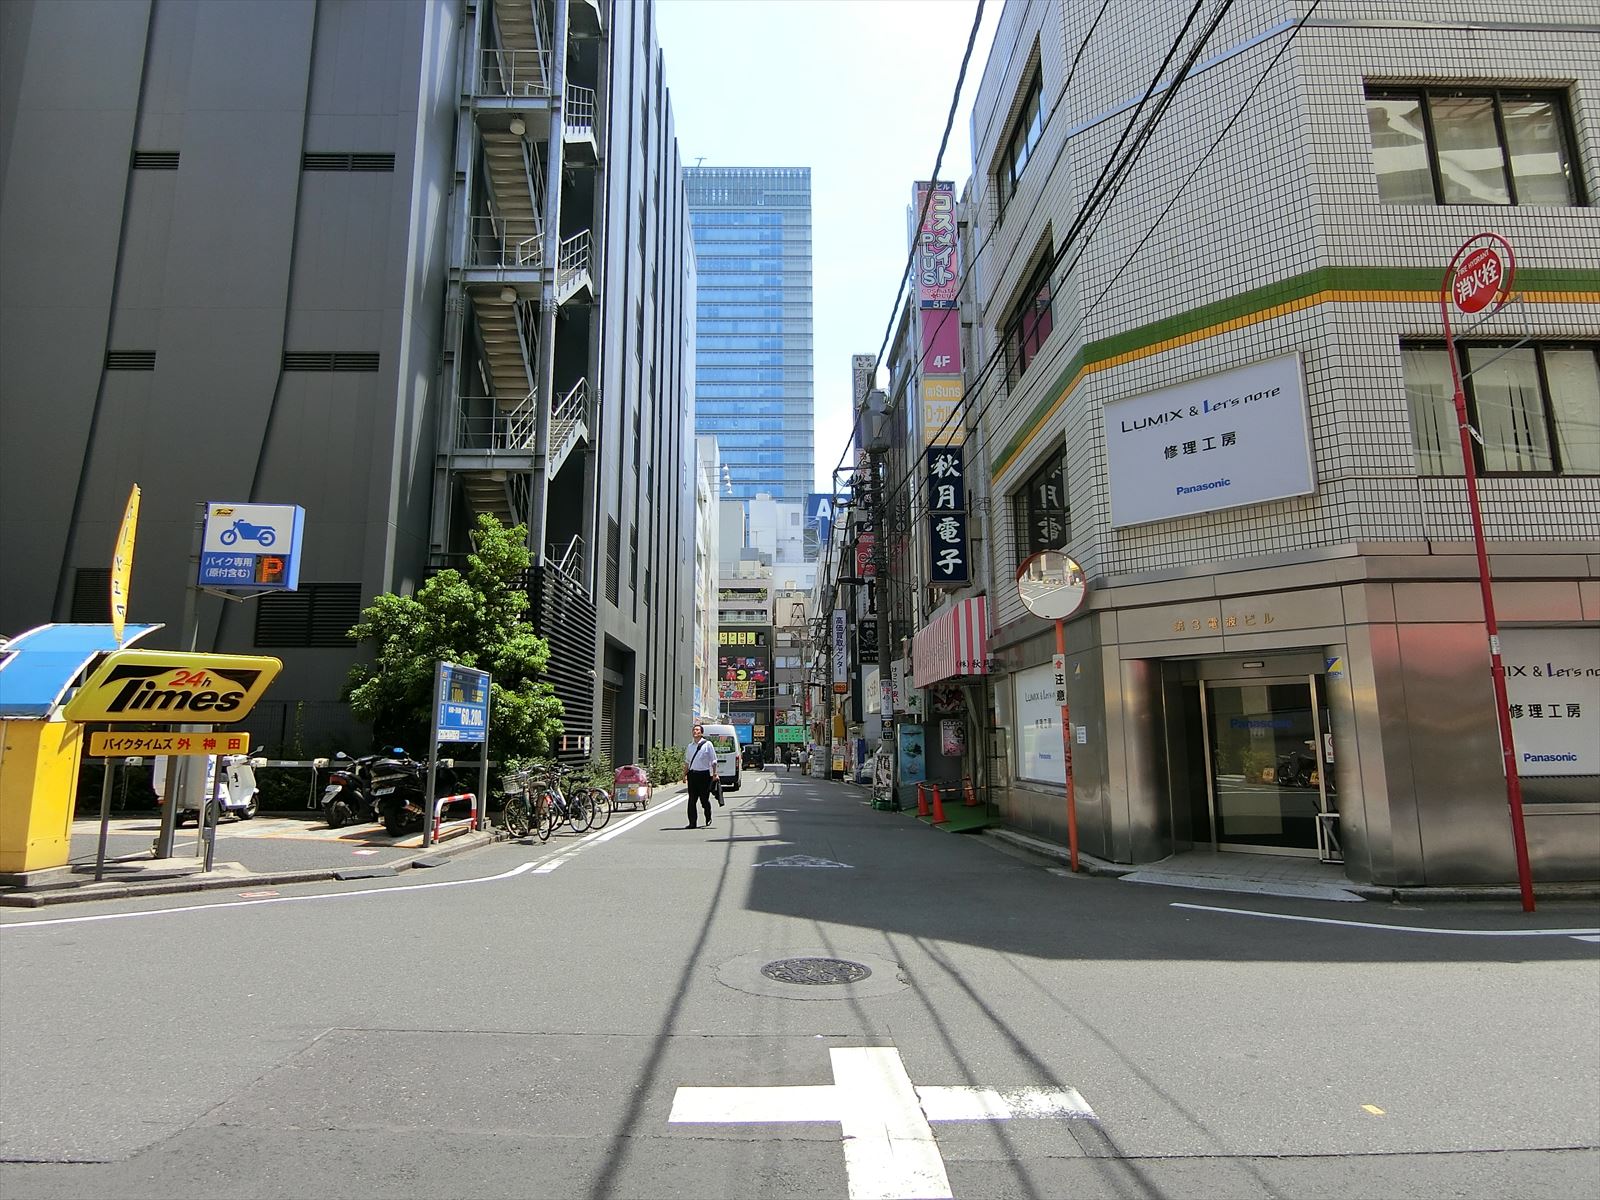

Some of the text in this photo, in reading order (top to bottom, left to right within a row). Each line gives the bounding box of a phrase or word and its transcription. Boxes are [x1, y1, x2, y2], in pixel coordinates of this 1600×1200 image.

[932, 194, 955, 287] コスメイト
[921, 232, 937, 287] PLUS
[1468, 249, 1490, 269] HYDRANT
[1456, 258, 1499, 304] 消火栓
[933, 300, 947, 308] 5F
[933, 355, 950, 367] 4F
[1121, 408, 1184, 433] LUMIX
[1189, 406, 1199, 417] &
[1163, 431, 1237, 460] 修理工房
[1176, 478, 1231, 495] Panasonic
[930, 454, 962, 576] 秋月電子
[206, 557, 253, 567] バイク専用
[261, 556, 283, 583] P
[205, 567, 250, 579] (原付含む)
[1174, 612, 1275, 632] 第3電波ビル
[835, 616, 844, 675] 高価買取センター
[168, 671, 211, 688] 24h
[1532, 666, 1543, 677] &
[106, 679, 244, 713] Times
[1055, 673, 1065, 701] 注意
[1509, 703, 1581, 719] 修理工房
[104, 738, 241, 750] バイクタイムズ 外神田
[1523, 752, 1577, 762] Panasonic
